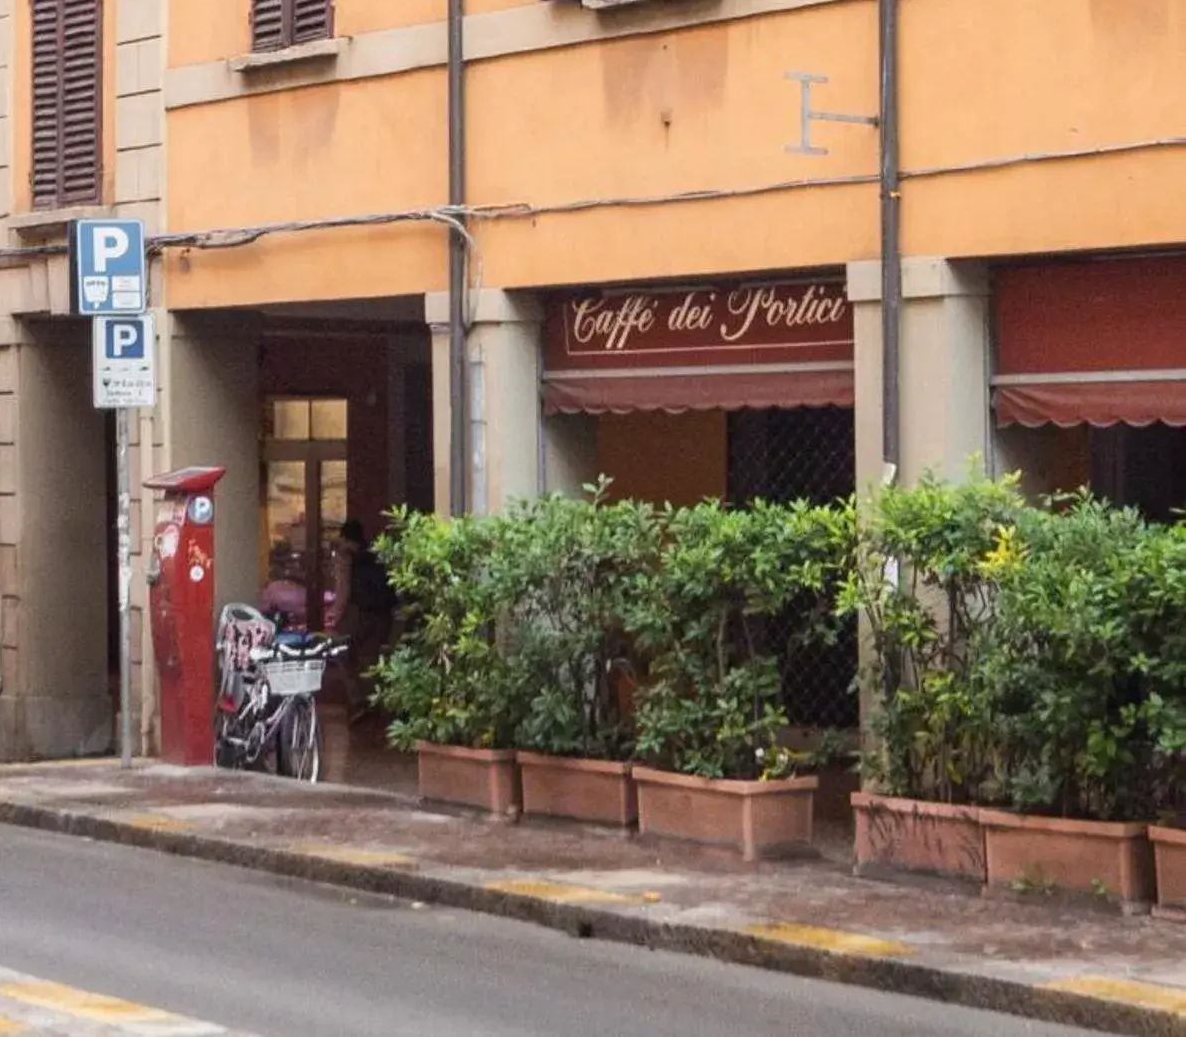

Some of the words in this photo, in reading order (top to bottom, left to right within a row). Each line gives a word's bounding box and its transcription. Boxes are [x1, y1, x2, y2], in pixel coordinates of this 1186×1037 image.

[92, 226, 129, 273] P
[668, 292, 715, 331] dei
[719, 285, 847, 341] Portici
[113, 324, 138, 357] P
[195, 496, 211, 518] P
